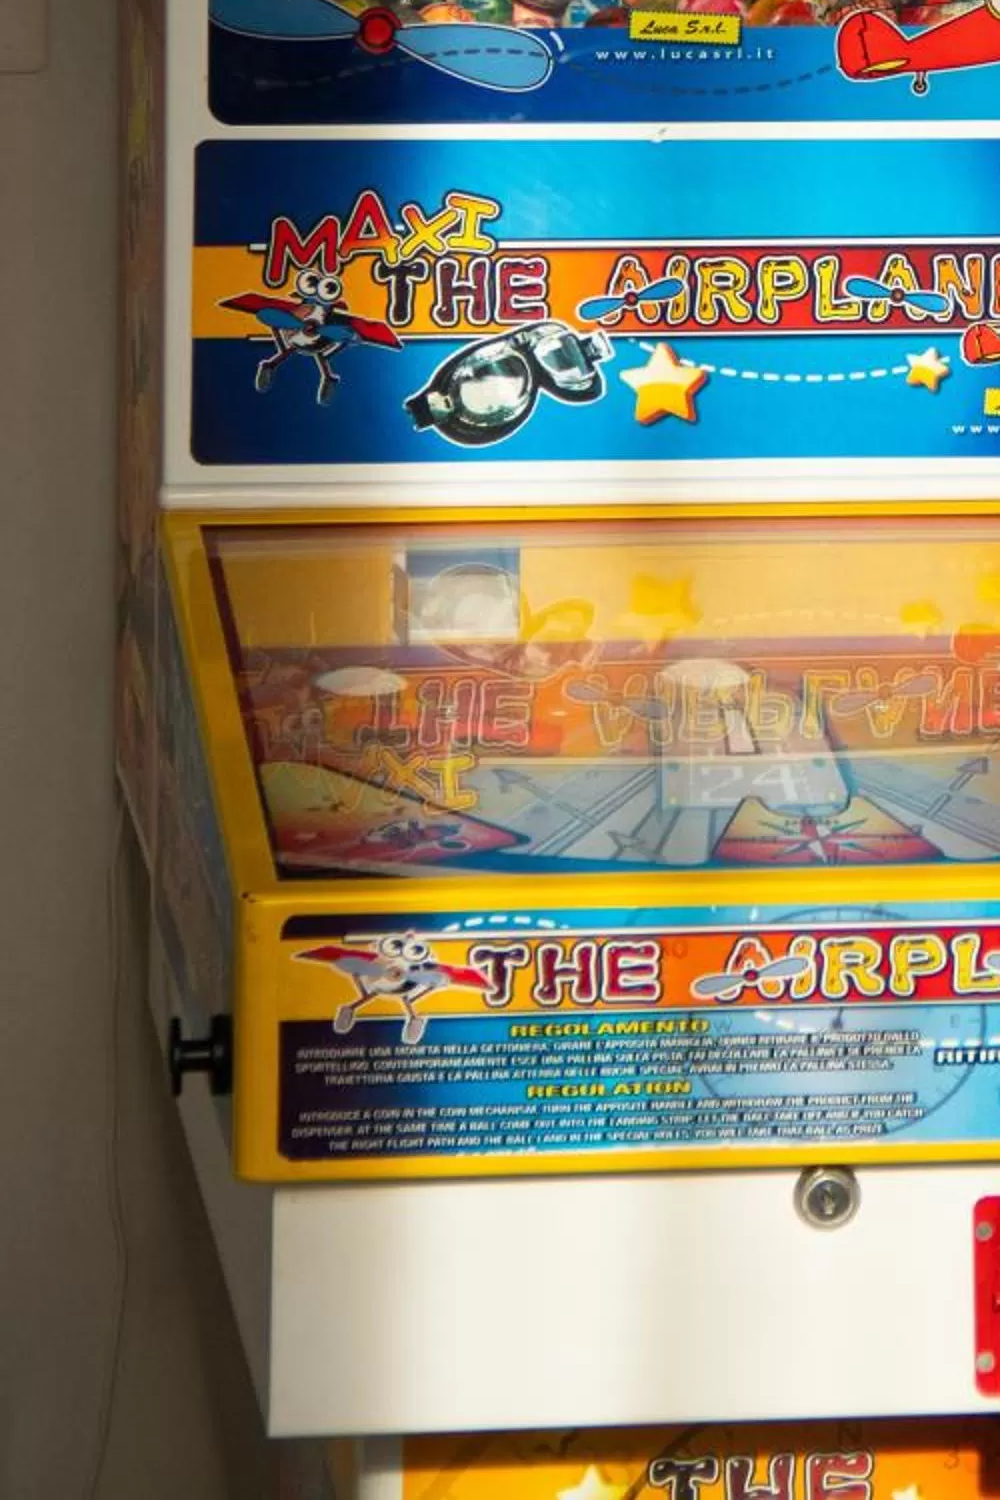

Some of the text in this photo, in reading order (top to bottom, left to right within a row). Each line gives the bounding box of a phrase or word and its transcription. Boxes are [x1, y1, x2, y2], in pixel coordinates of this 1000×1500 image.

[639, 19, 679, 35] Luca
[595, 47, 776, 60] www.lucasrl.it
[265, 188, 505, 288] MAXI
[373, 256, 550, 327] THE
[467, 938, 665, 1007] THE
[511, 1019, 709, 1037] REGOLAMENTO
[526, 1080, 693, 1099] REGULATION
